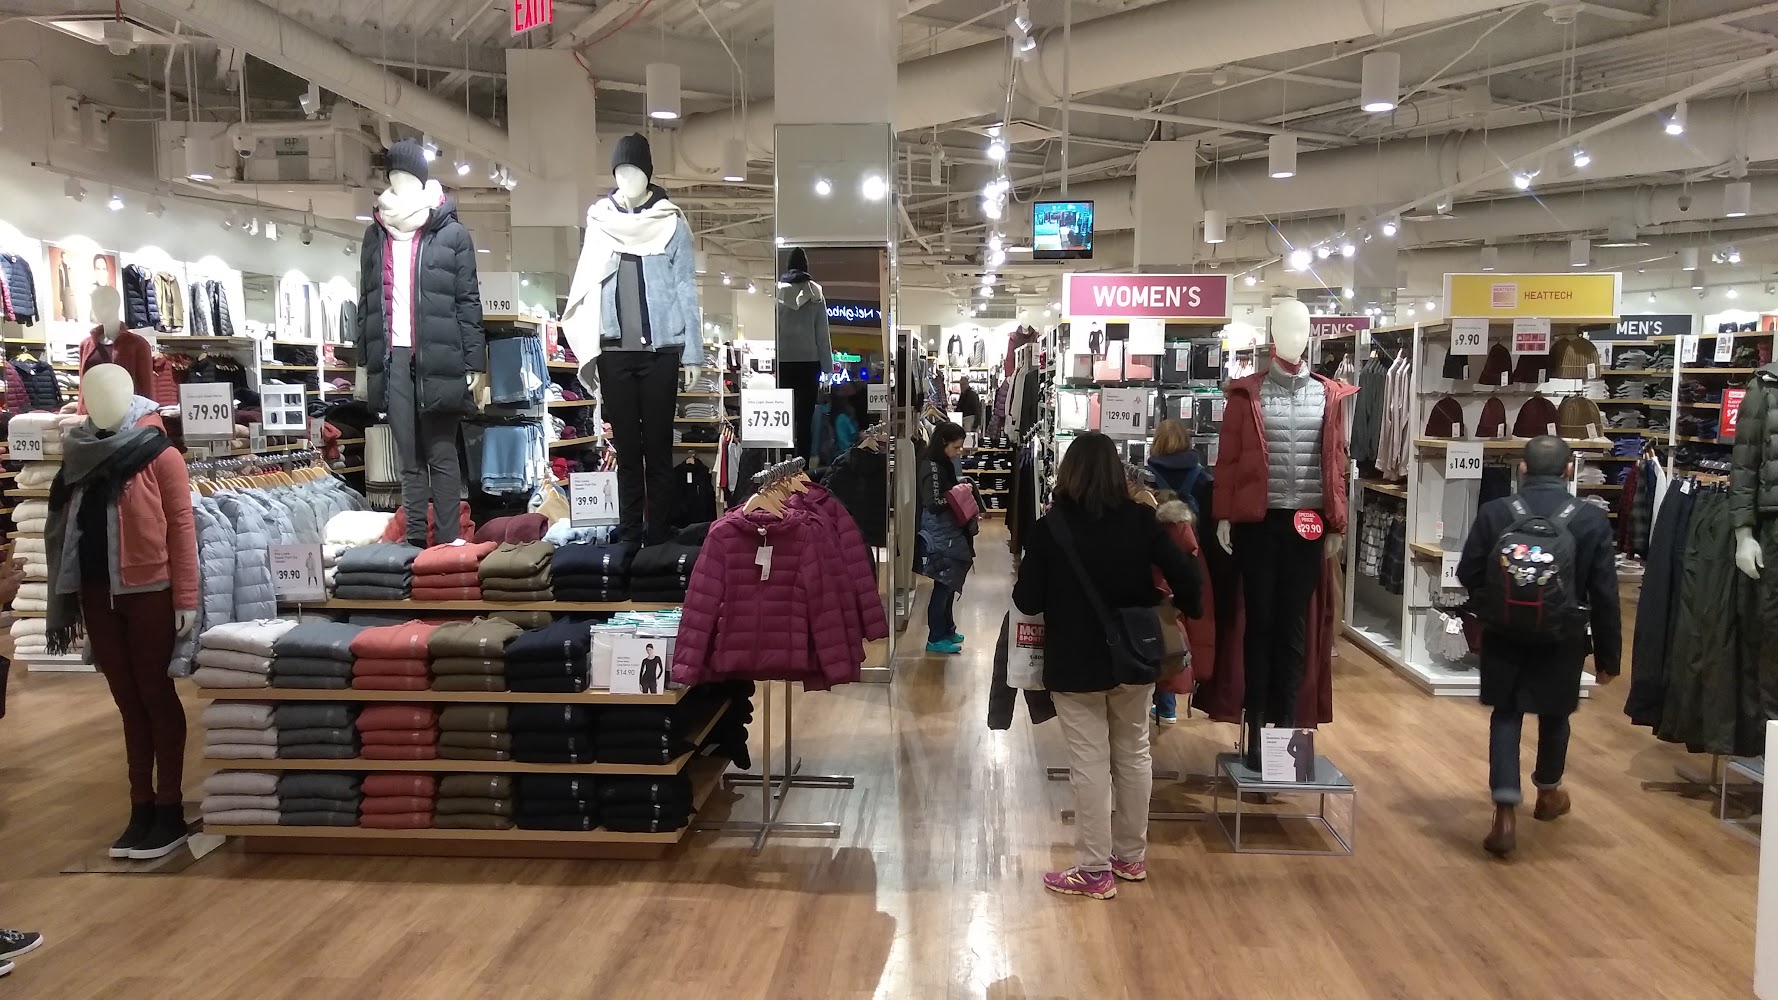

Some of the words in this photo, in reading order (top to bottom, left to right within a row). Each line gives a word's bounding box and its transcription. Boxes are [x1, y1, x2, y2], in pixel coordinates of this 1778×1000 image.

[1093, 285, 1202, 308] WOMEN'S
[1524, 291, 1573, 300] HEATTECH
[1310, 323, 1355, 337] MEN'S
[1616, 320, 1663, 335] MEN'S
[1455, 334, 1480, 346] $9.90
[188, 404, 229, 420] $79.90
[747, 410, 790, 427] $79.90
[13, 440, 40, 451] $29.90
[1450, 458, 1480, 469] $14.90
[1298, 524, 1322, 534] $29.90
